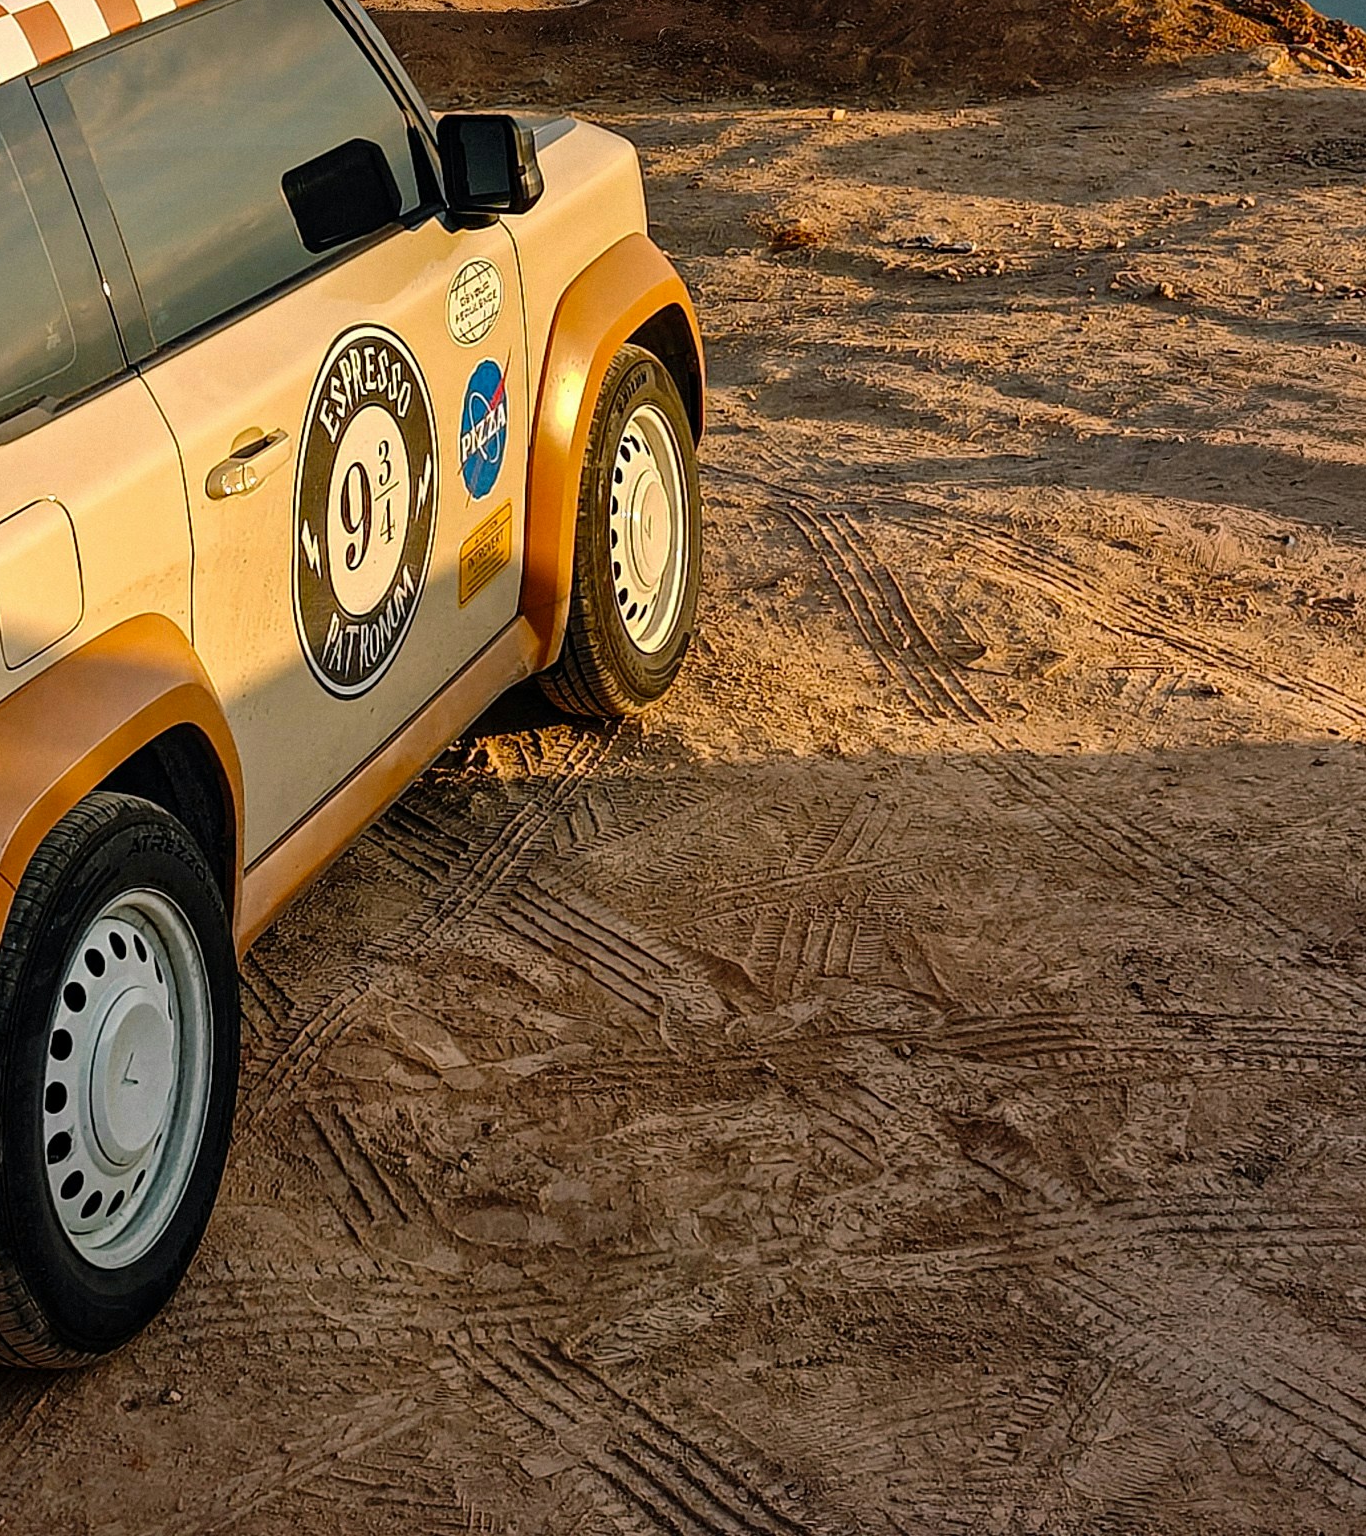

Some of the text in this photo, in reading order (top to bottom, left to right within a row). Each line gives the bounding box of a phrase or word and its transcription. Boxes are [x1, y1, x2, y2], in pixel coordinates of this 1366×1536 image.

[318, 345, 412, 444] ESPRESSO
[461, 402, 507, 464] PIZZA
[320, 564, 416, 678] PATRONUM
